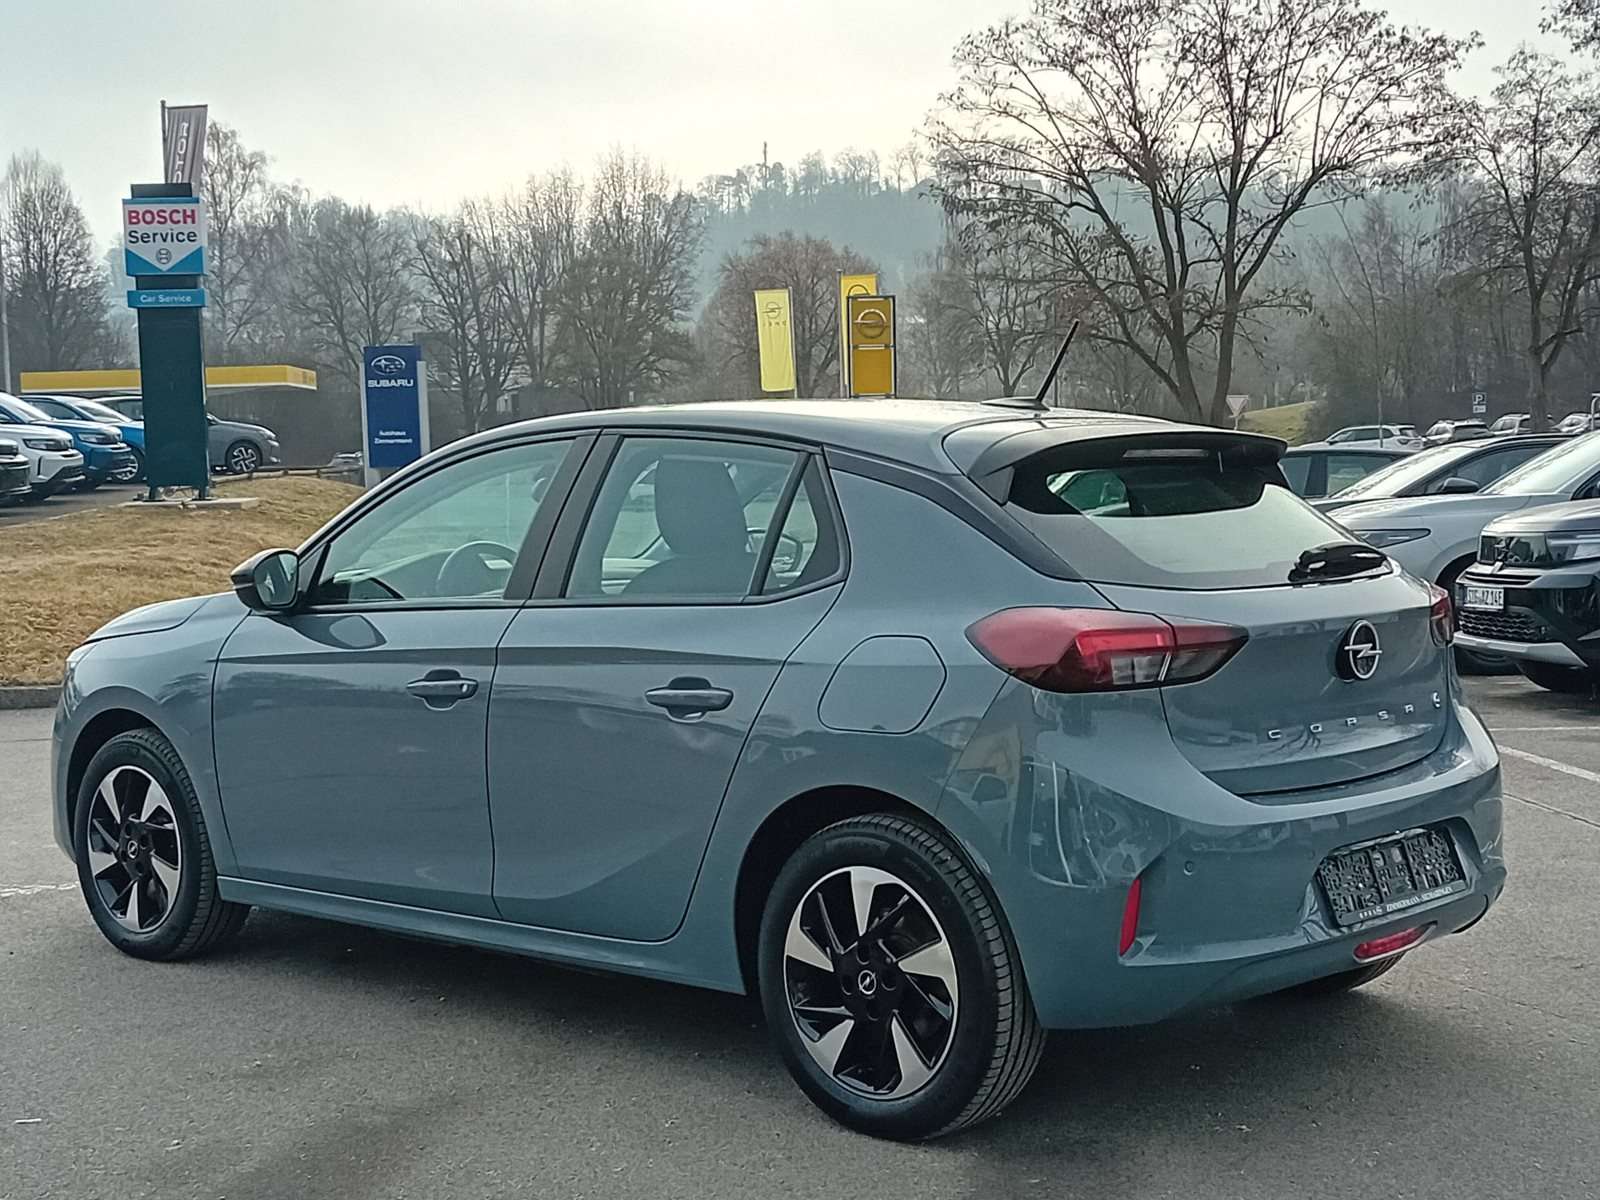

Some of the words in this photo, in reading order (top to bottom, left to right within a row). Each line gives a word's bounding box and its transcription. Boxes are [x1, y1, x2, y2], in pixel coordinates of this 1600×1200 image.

[127, 208, 196, 226] BOSCH
[128, 228, 198, 244] Service
[140, 294, 156, 303] Car
[158, 294, 192, 303] Service
[367, 378, 414, 388] SUBARU
